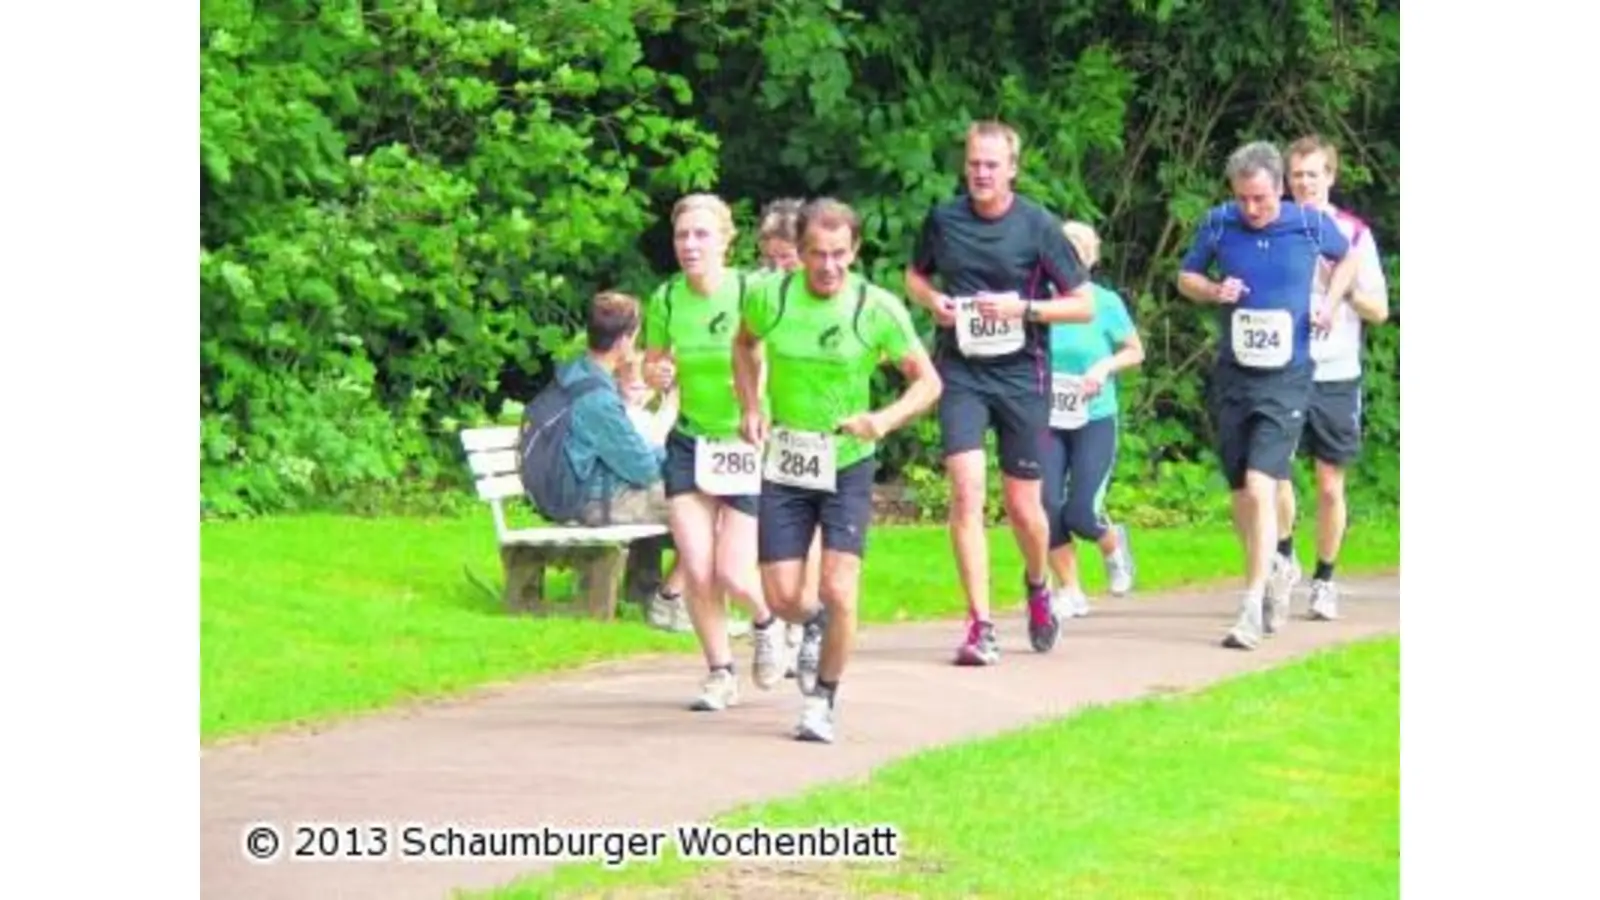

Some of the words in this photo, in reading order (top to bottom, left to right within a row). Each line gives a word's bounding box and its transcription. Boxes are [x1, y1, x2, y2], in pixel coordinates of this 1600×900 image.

[1243, 328, 1280, 349] 324
[711, 452, 756, 475] 286
[780, 449, 821, 478] 284
